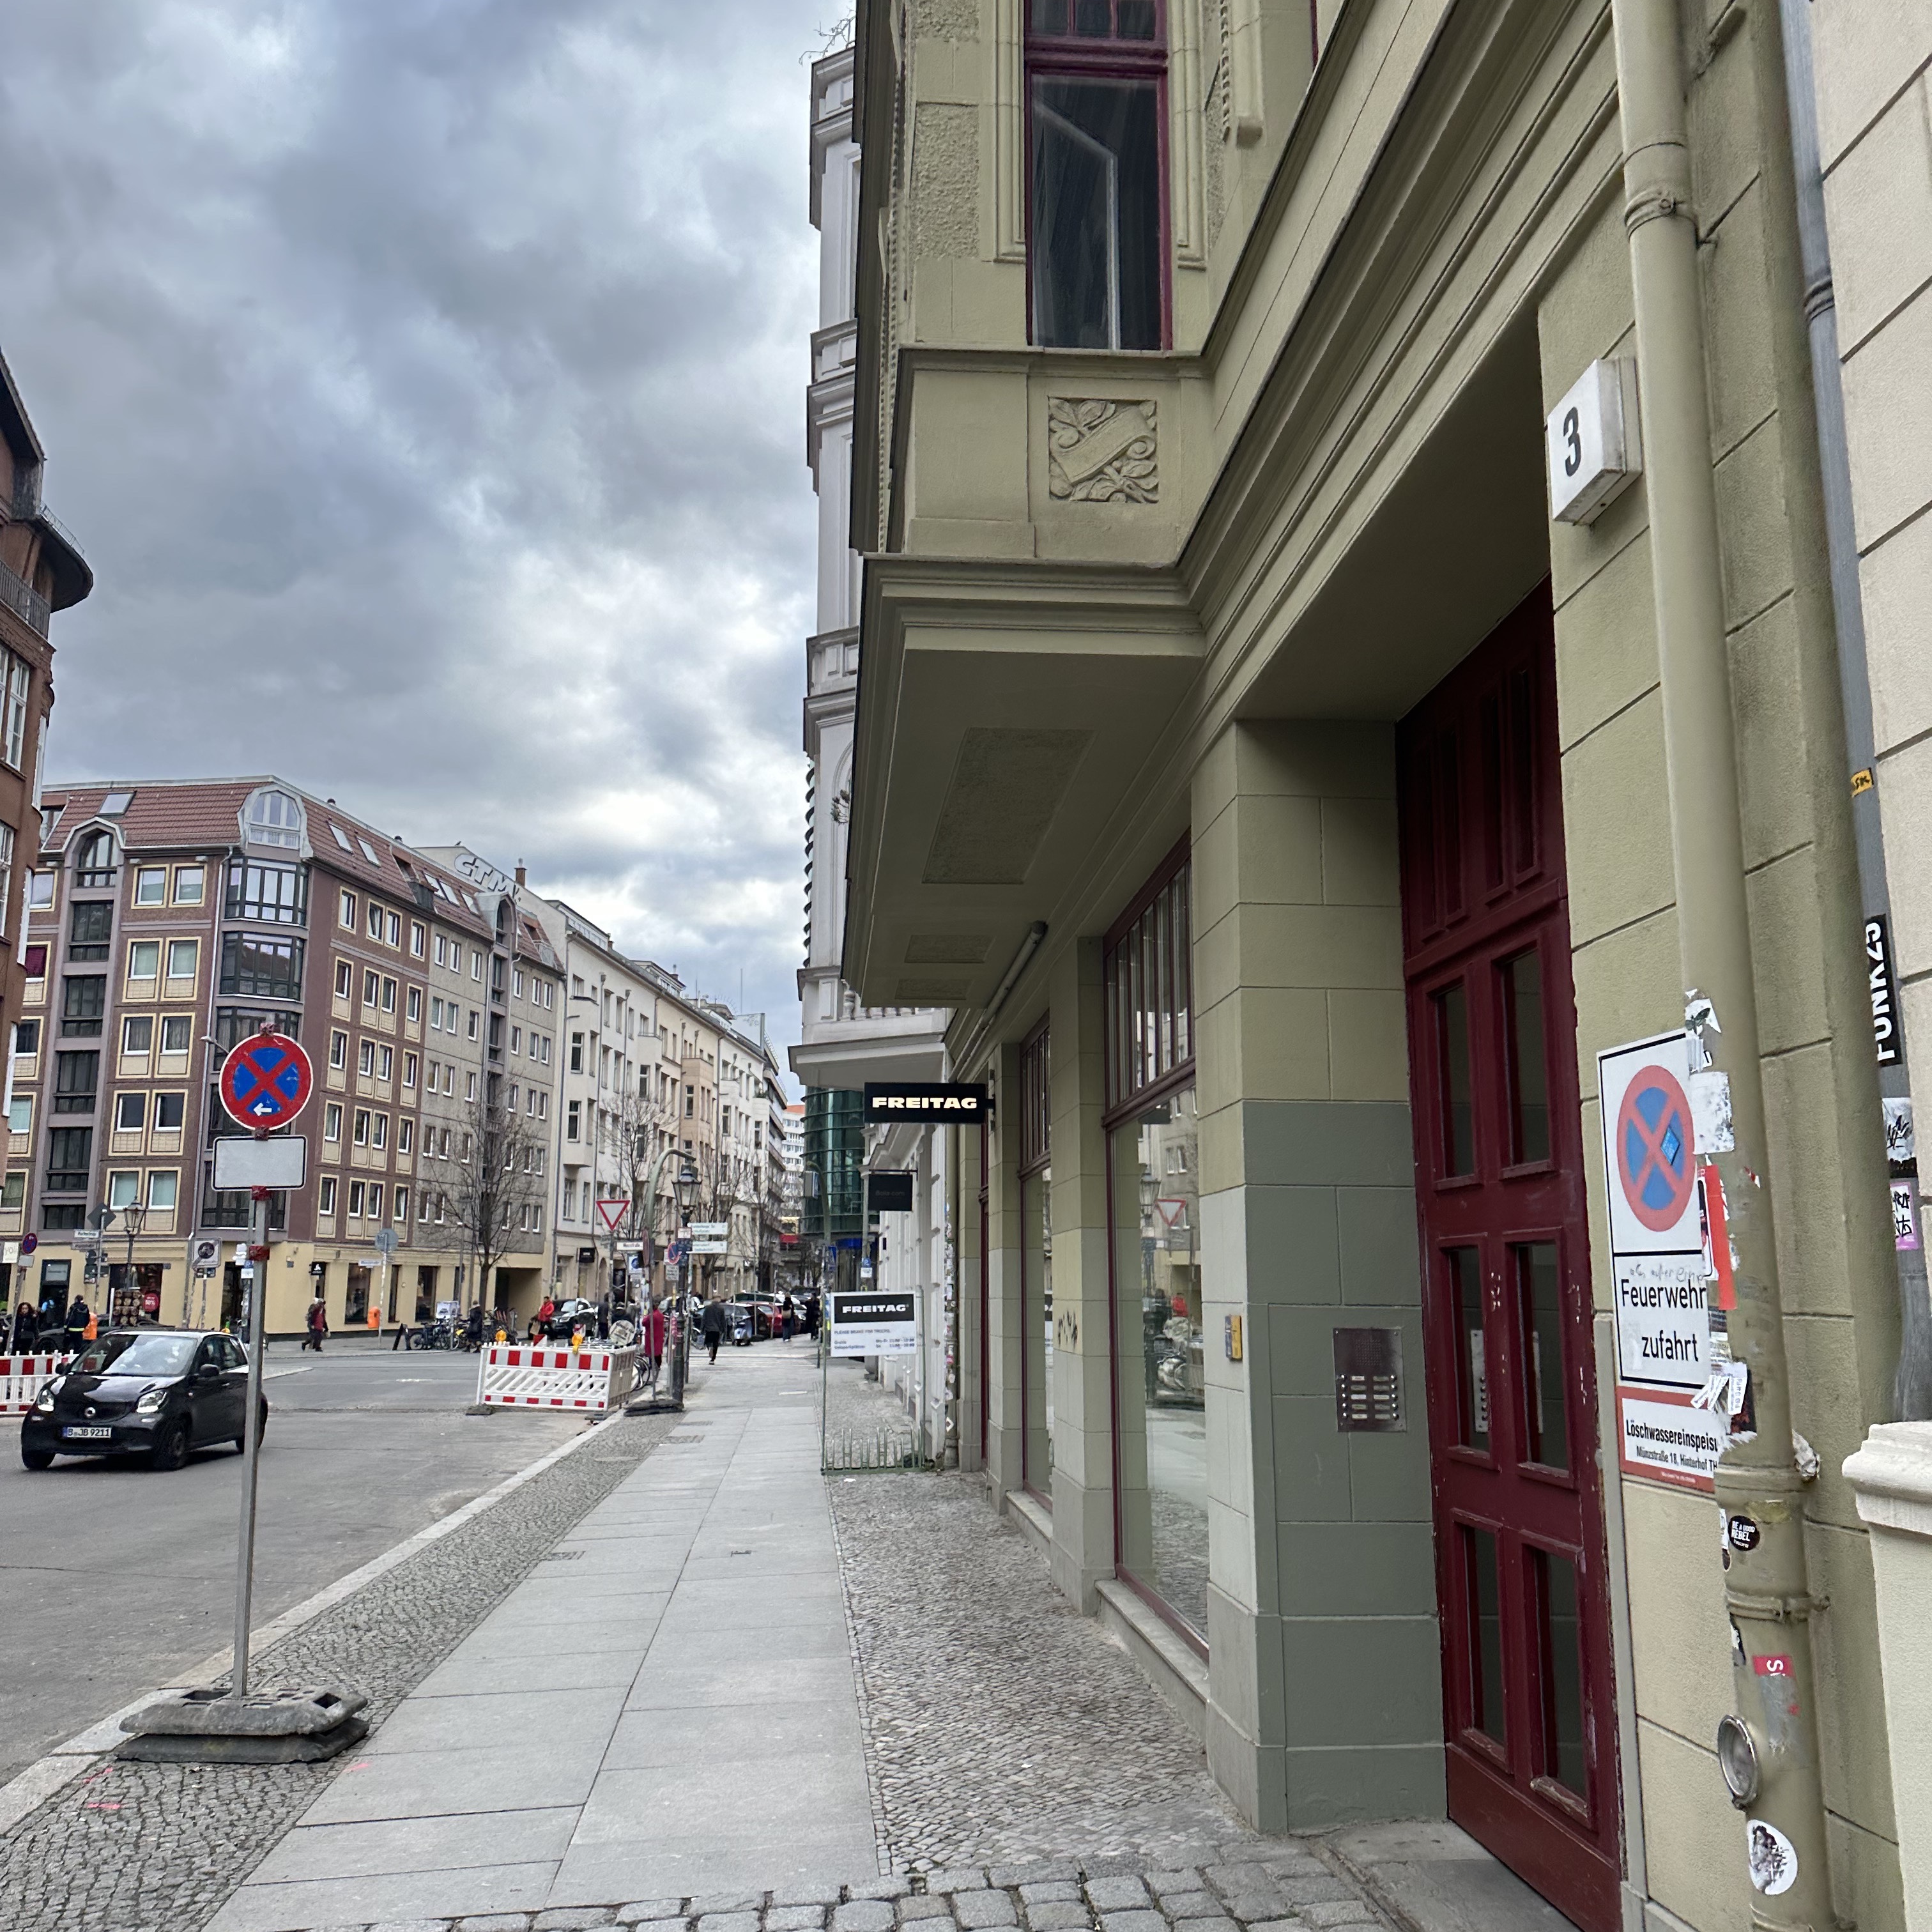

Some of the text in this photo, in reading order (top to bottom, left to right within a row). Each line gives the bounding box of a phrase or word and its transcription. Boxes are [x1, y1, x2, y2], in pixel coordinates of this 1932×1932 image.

[1563, 406, 1582, 477] 3
[871, 1096, 977, 1109] FREITAG
[1621, 1278, 1706, 1309] Feuerwehr
[842, 1304, 906, 1314] FREITAG
[1641, 1330, 1699, 1362] zufahrt
[1680, 1453, 1707, 1470] Hinterhof
[1731, 1529, 1751, 1542] REBEL
